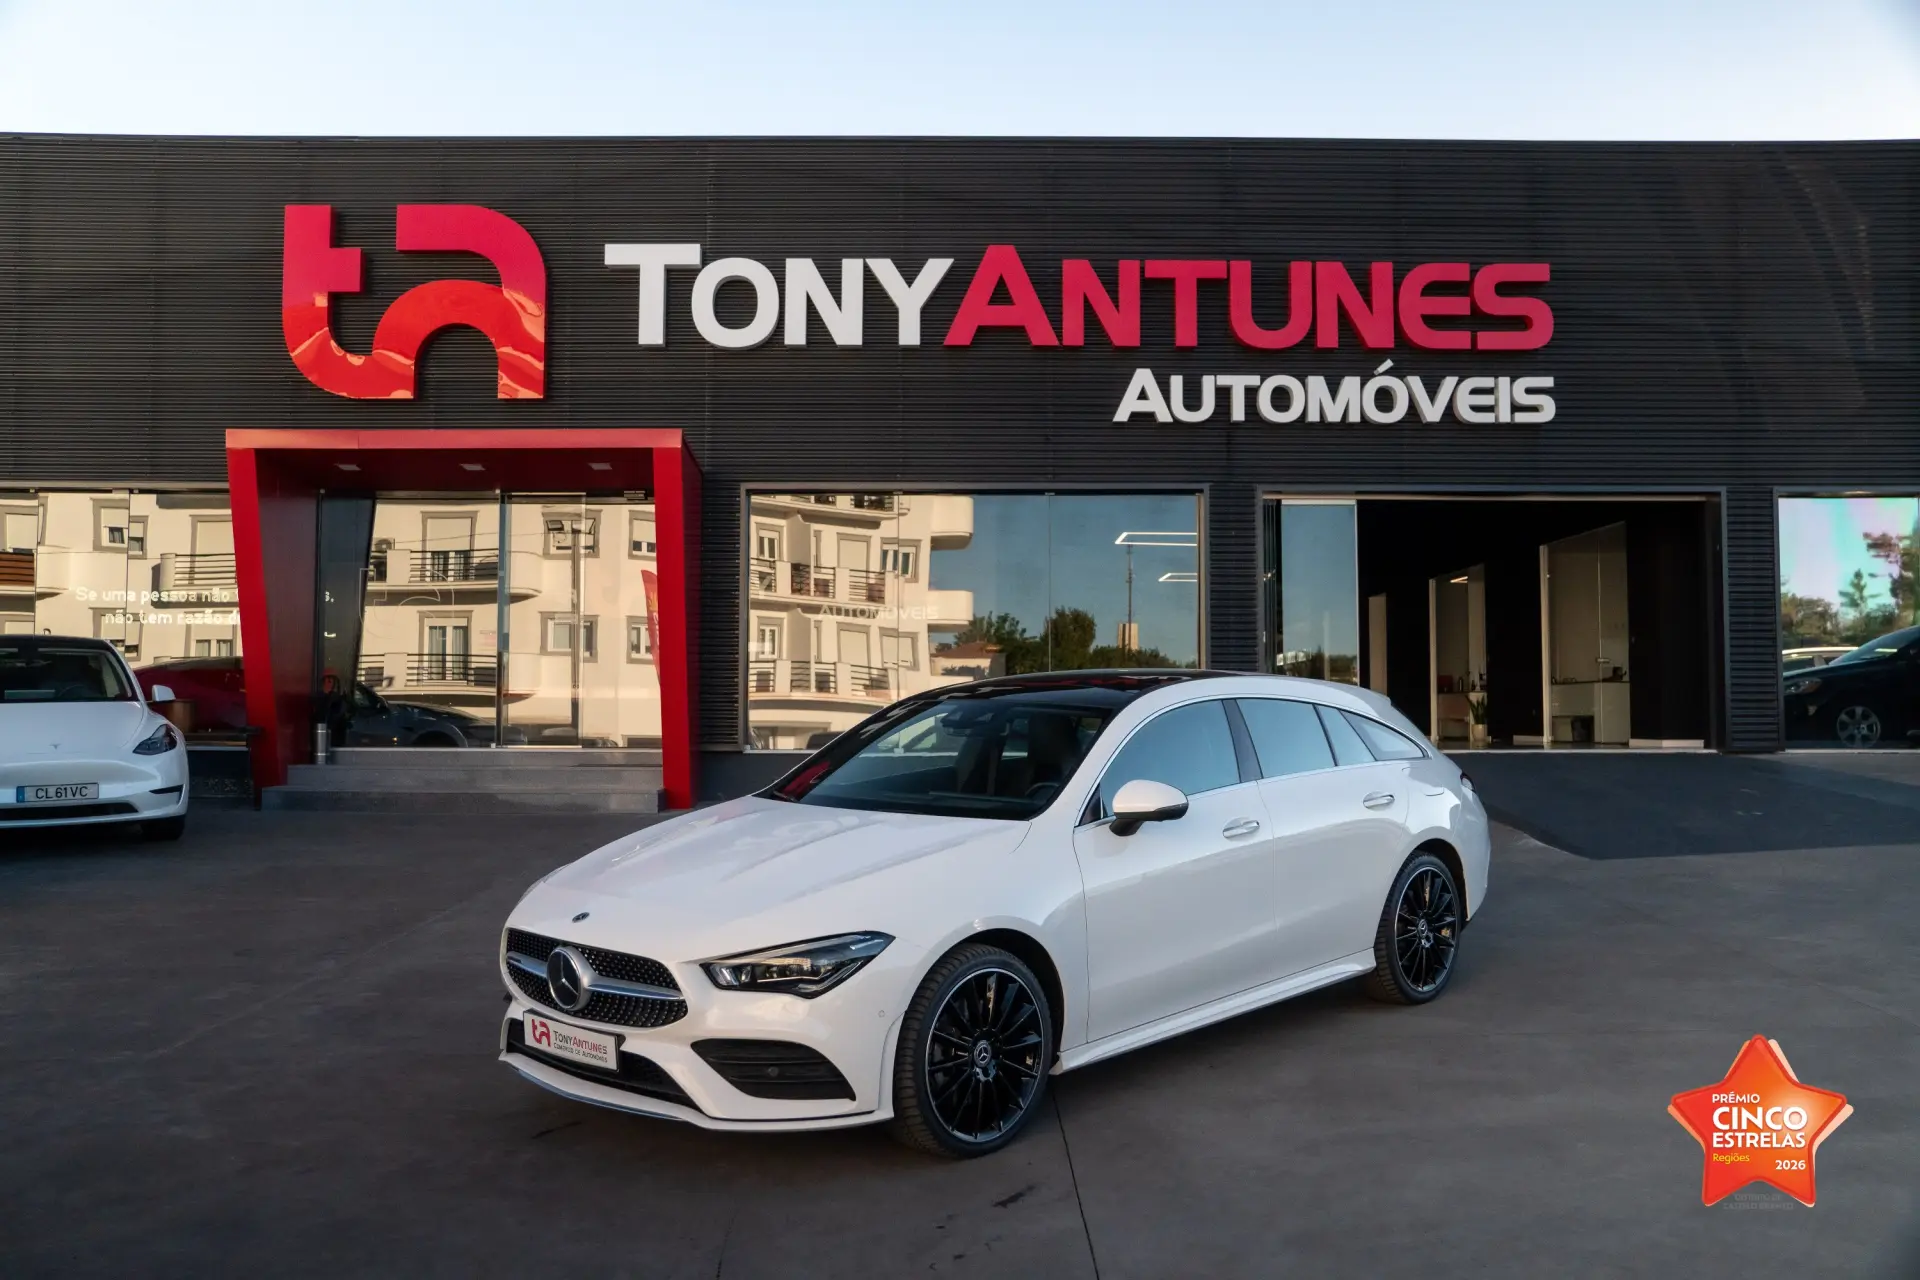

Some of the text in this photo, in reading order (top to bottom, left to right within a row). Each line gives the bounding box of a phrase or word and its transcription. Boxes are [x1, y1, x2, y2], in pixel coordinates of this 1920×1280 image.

[1112, 358, 1556, 425] AUTOMÓVEIS
[102, 589, 136, 602] uma
[141, 589, 198, 605] pessoa
[202, 587, 230, 602] não
[105, 609, 133, 624] não
[140, 610, 173, 624] tem
